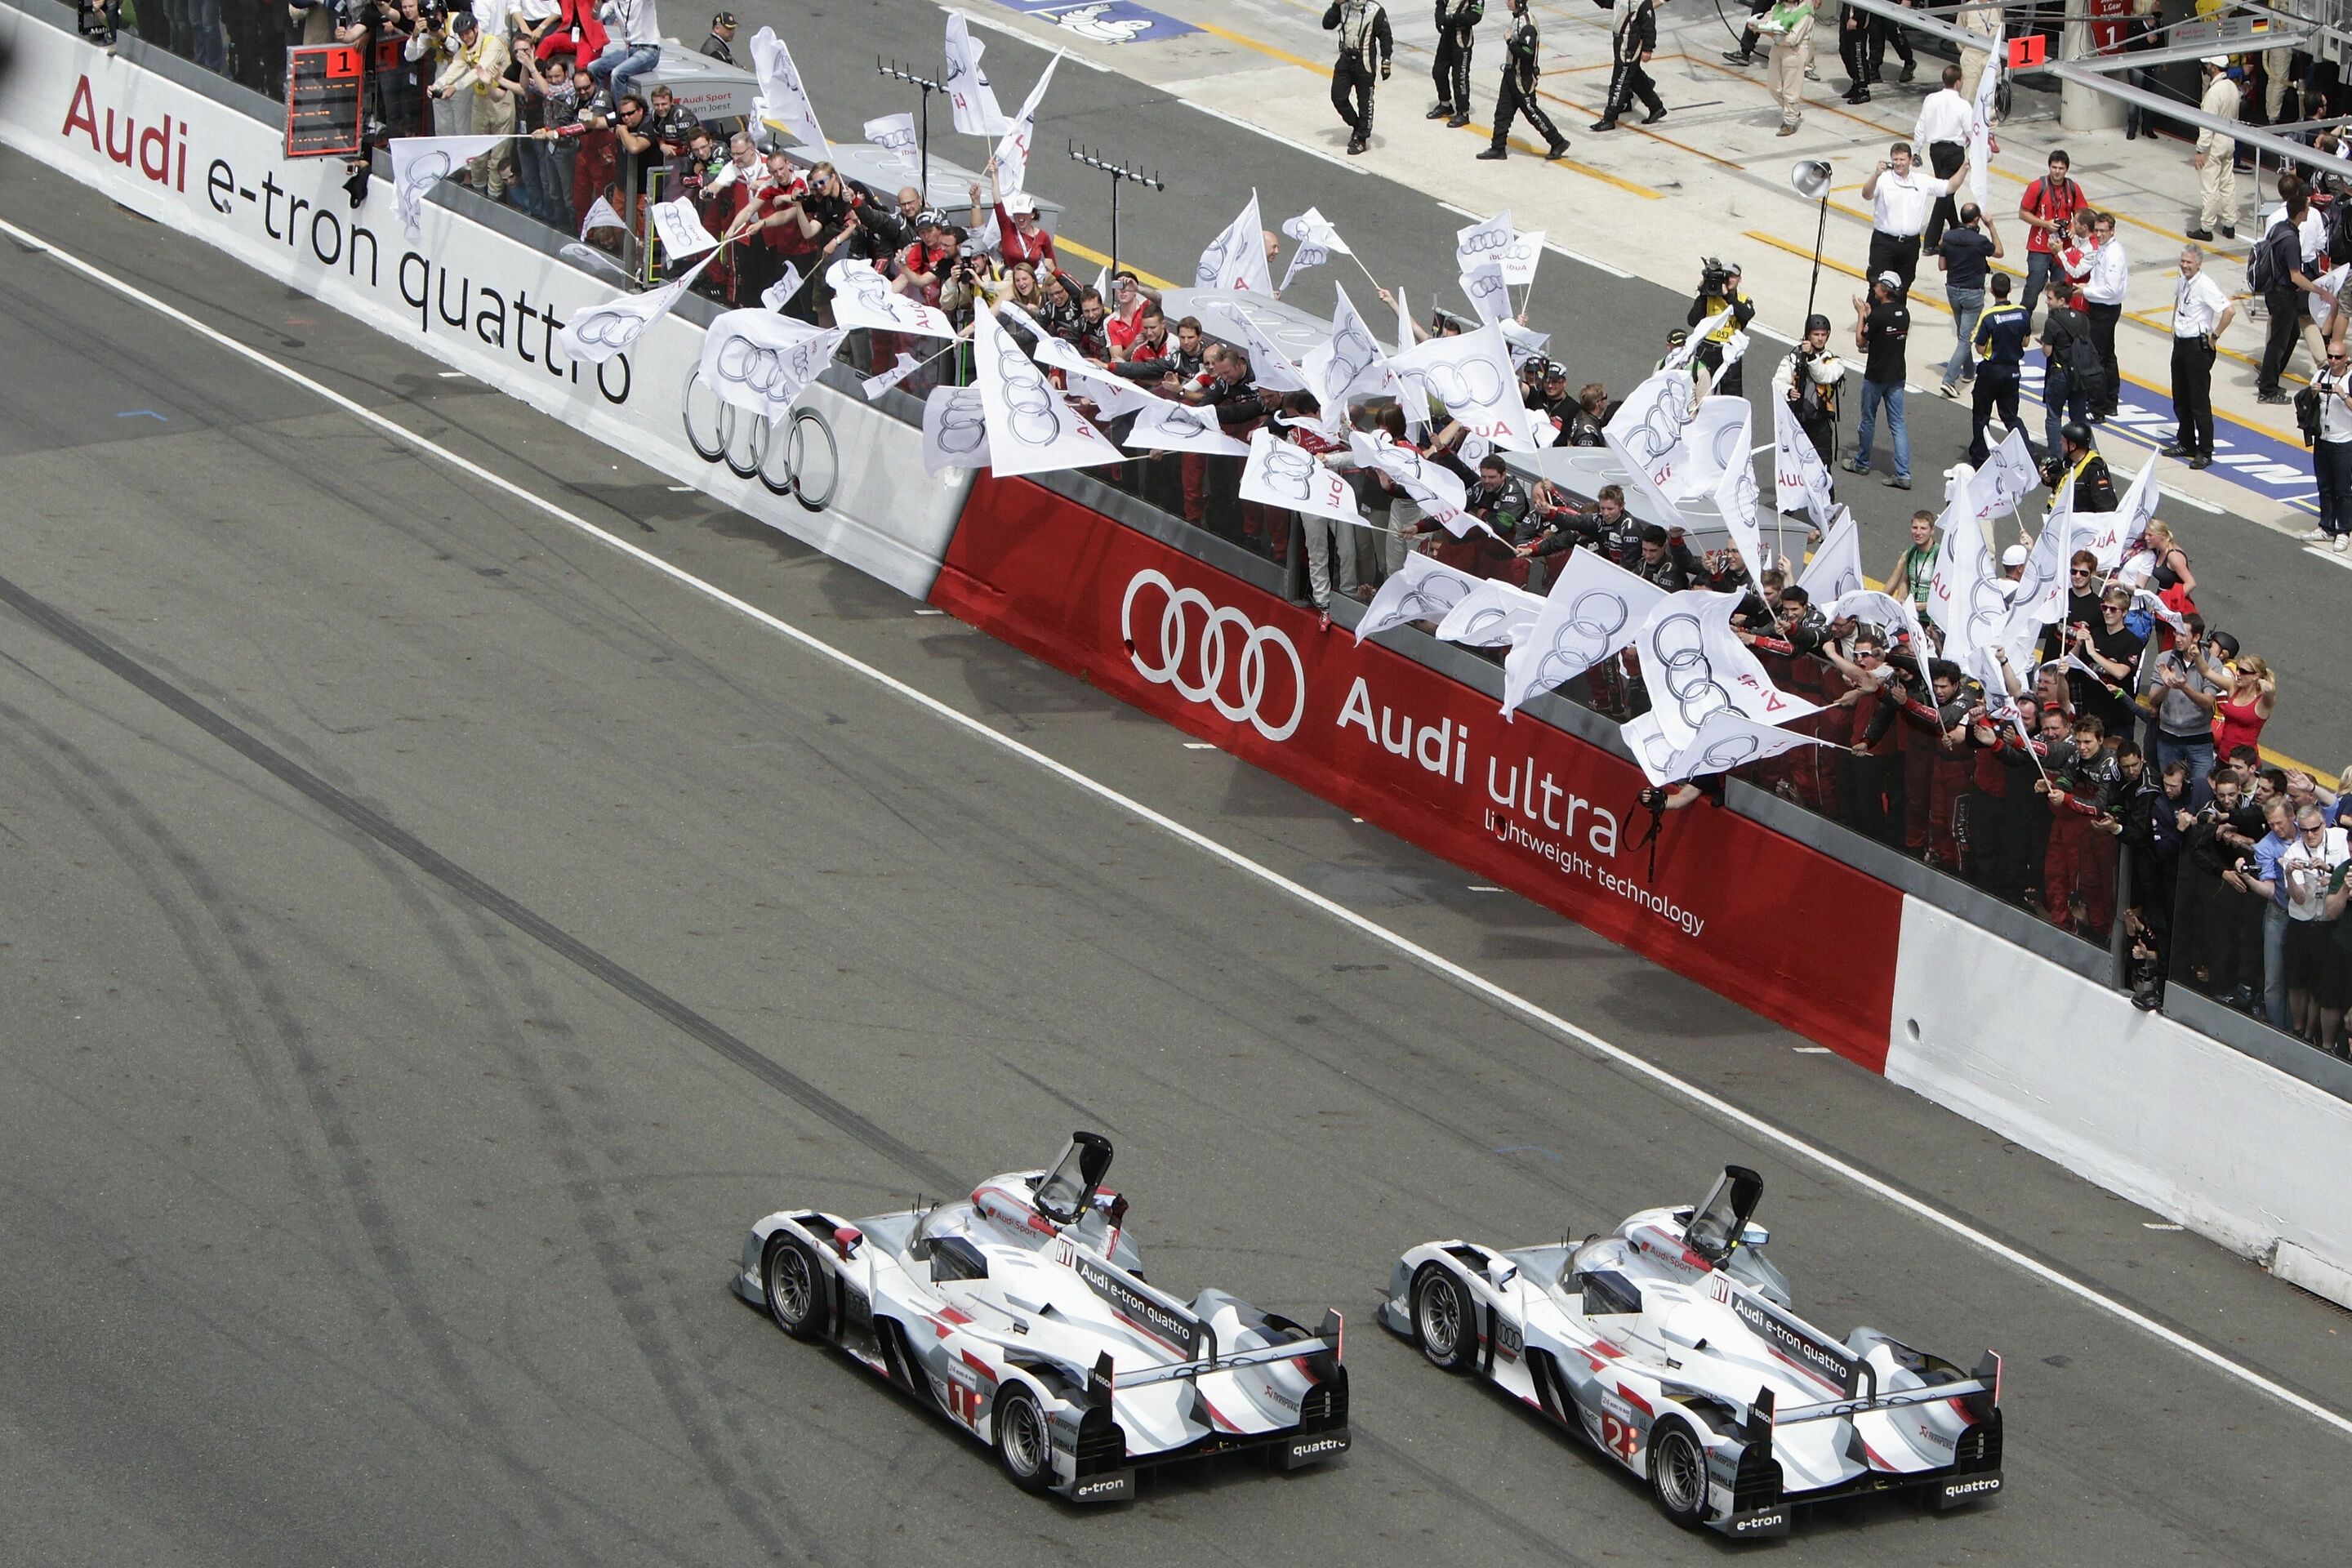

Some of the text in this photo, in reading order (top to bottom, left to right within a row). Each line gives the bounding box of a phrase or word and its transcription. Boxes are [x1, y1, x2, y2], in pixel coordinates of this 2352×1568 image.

[2106, 25, 2119, 50] 1
[337, 51, 352, 73] 1
[2020, 39, 2033, 65] 1
[683, 92, 732, 105] Audi Sport
[709, 103, 731, 112] Joest
[62, 74, 187, 194] Audi
[207, 158, 378, 287] e-tron
[904, 301, 933, 331] Aud
[1654, 462, 1671, 486] di
[1779, 469, 1804, 487] Au
[1931, 572, 1951, 602] Au
[1337, 676, 1617, 858] Audi ultra
[1597, 865, 1705, 938] technology
[996, 1211, 1037, 1239] Audi Sport
[1057, 1240, 1074, 1267] HY
[1650, 1246, 1692, 1274] Audi Sport
[1080, 1263, 1191, 1340] Audi e-tron quattro
[1711, 1276, 1729, 1303] HY
[1735, 1299, 1847, 1379] Audi e-tron quattro
[1094, 1374, 1111, 1389] BOSCH
[955, 1384, 969, 1423] 1
[1755, 1408, 1772, 1424] BOSCH
[1053, 1437, 1075, 1454] MAHLE
[1607, 1417, 1624, 1458] 2
[1078, 1477, 1124, 1496] e-tron
[1711, 1471, 1733, 1489] MAHLE
[1945, 1479, 2000, 1498] quattro
[1736, 1513, 1782, 1532] e-tron
